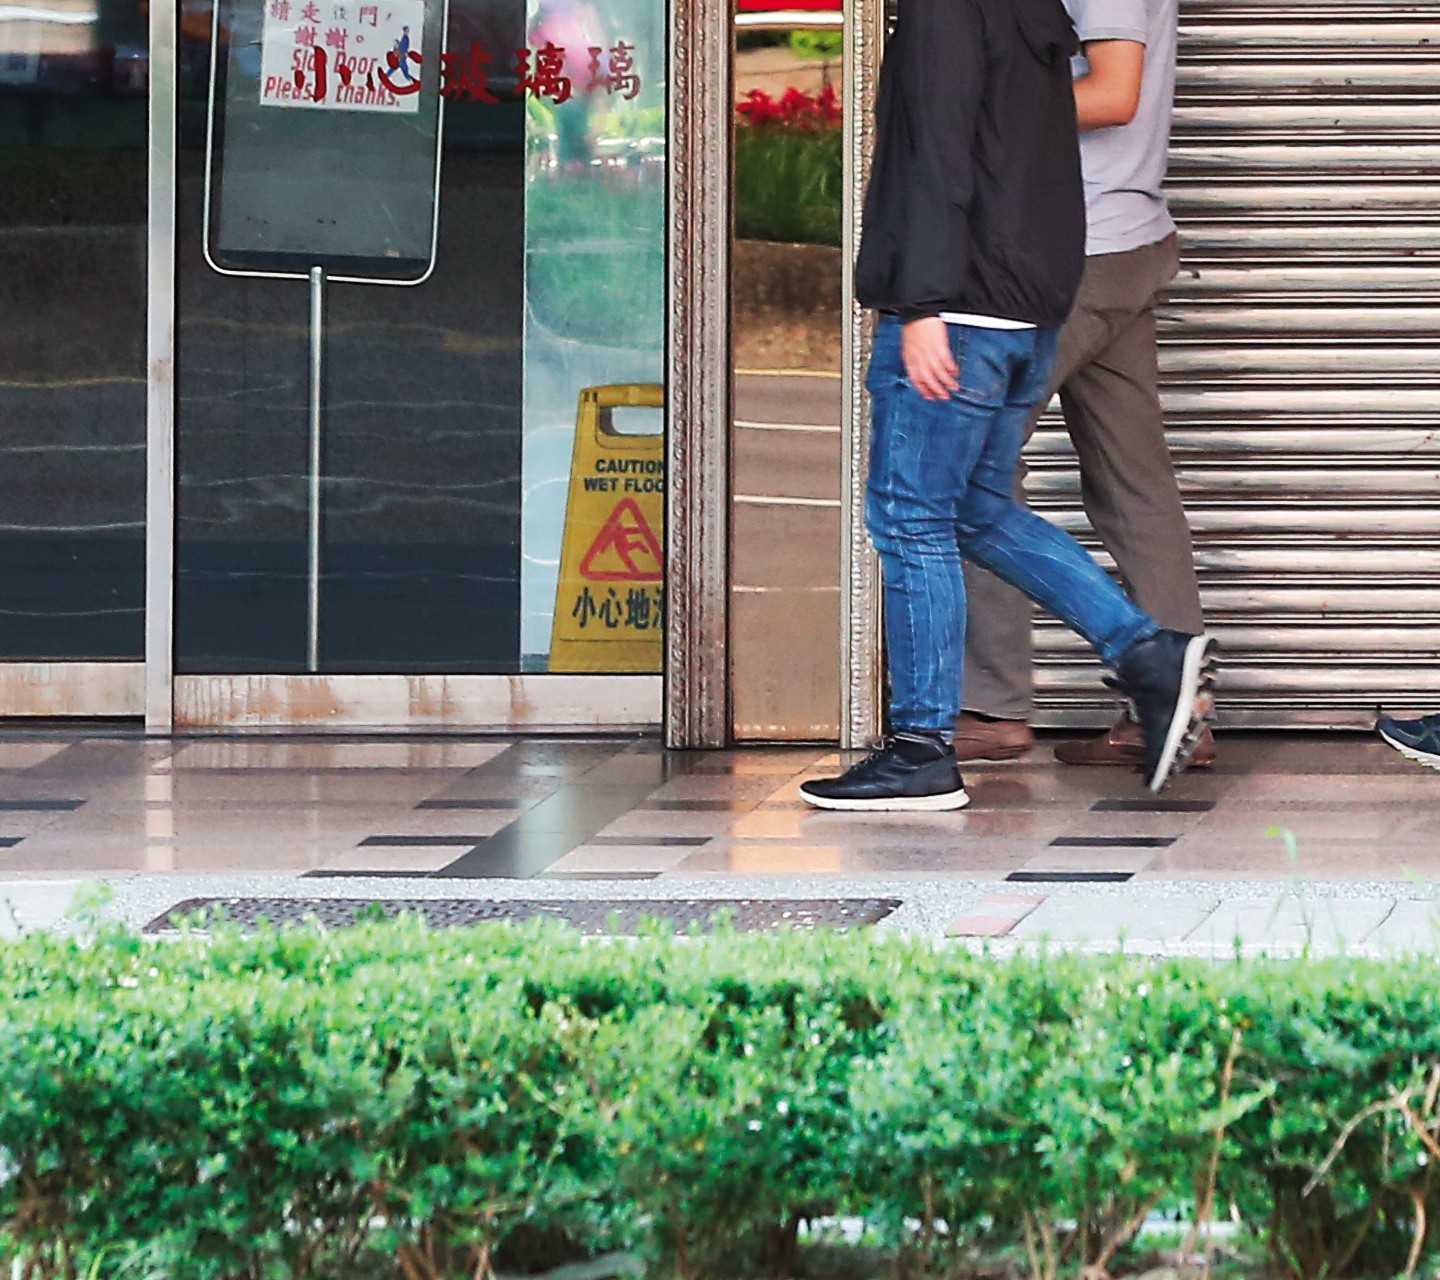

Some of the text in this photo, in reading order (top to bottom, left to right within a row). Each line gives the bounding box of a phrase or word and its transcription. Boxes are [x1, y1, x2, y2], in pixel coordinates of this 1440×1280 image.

[584, 477, 619, 492] WET
[572, 586, 664, 630] 小心地
